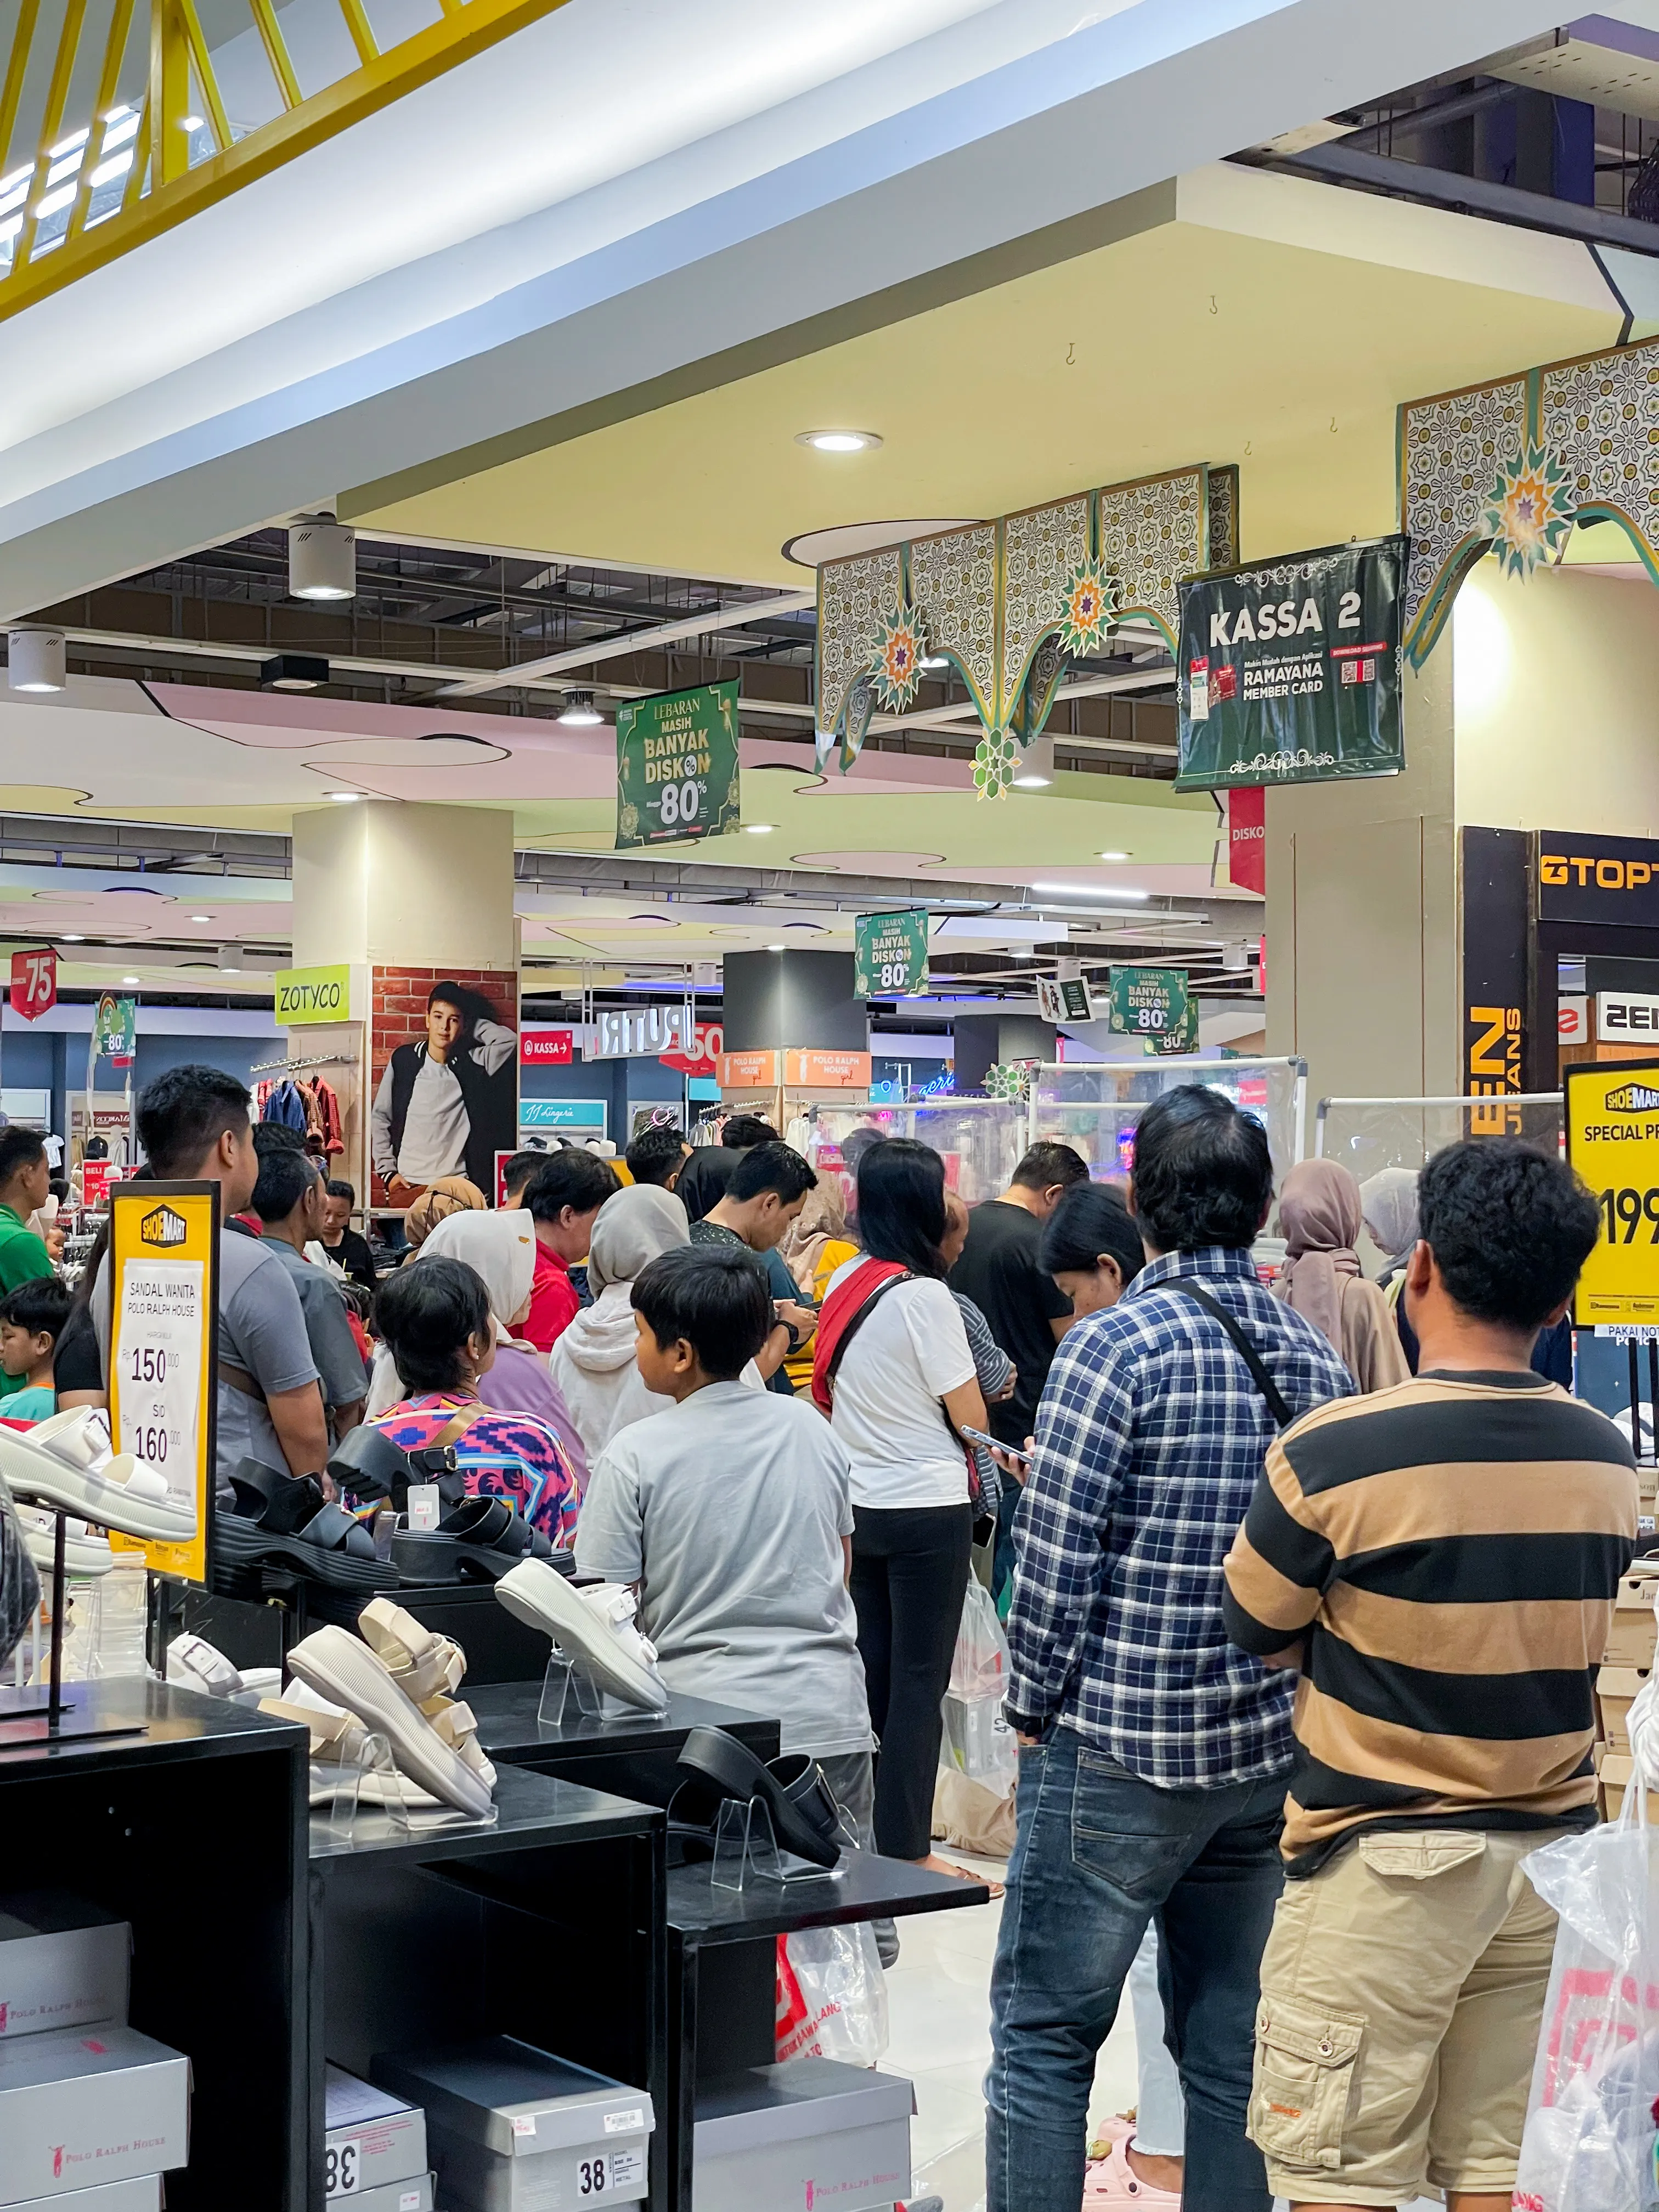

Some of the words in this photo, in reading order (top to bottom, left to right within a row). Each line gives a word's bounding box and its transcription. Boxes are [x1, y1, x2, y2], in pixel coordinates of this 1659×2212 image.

[1210, 598, 1323, 647] KASSA
[1338, 591, 1361, 628] 2
[1244, 662, 1323, 686] RAMAYANA
[1243, 684, 1289, 701] MEMBER
[1291, 680, 1323, 695] CARD
[654, 698, 700, 720] LEBARAN
[661, 716, 691, 733] MASIH
[645, 728, 709, 759] BANYAK
[878, 918, 905, 928] LEBARAN
[883, 928, 900, 936] MASIH
[872, 935, 911, 950] BANYAK
[1135, 972, 1164, 980] LEBARAN
[280, 983, 340, 1012] ZOTYCO
[1128, 985, 1169, 997] BANYAK
[534, 1042, 559, 1053] KASSA
[813, 1056, 833, 1064] POLO
[835, 1057, 859, 1065] RALPH
[823, 1065, 849, 1074] HOUSE
[840, 1070, 854, 1085] girl
[541, 1107, 574, 1124] Lingerie
[1584, 1124, 1643, 1141] SPECIAL
[143, 1210, 185, 1241] SHOEMART
[130, 1282, 163, 1297] SANDAL
[165, 1283, 195, 1299] WANITA
[128, 1302, 145, 1314] POLO
[146, 1304, 171, 1315] RALPH
[172, 1305, 194, 1317] HOUSE
[1609, 1326, 1638, 1336] PAKAI
[580, 2159, 605, 2194] 38
